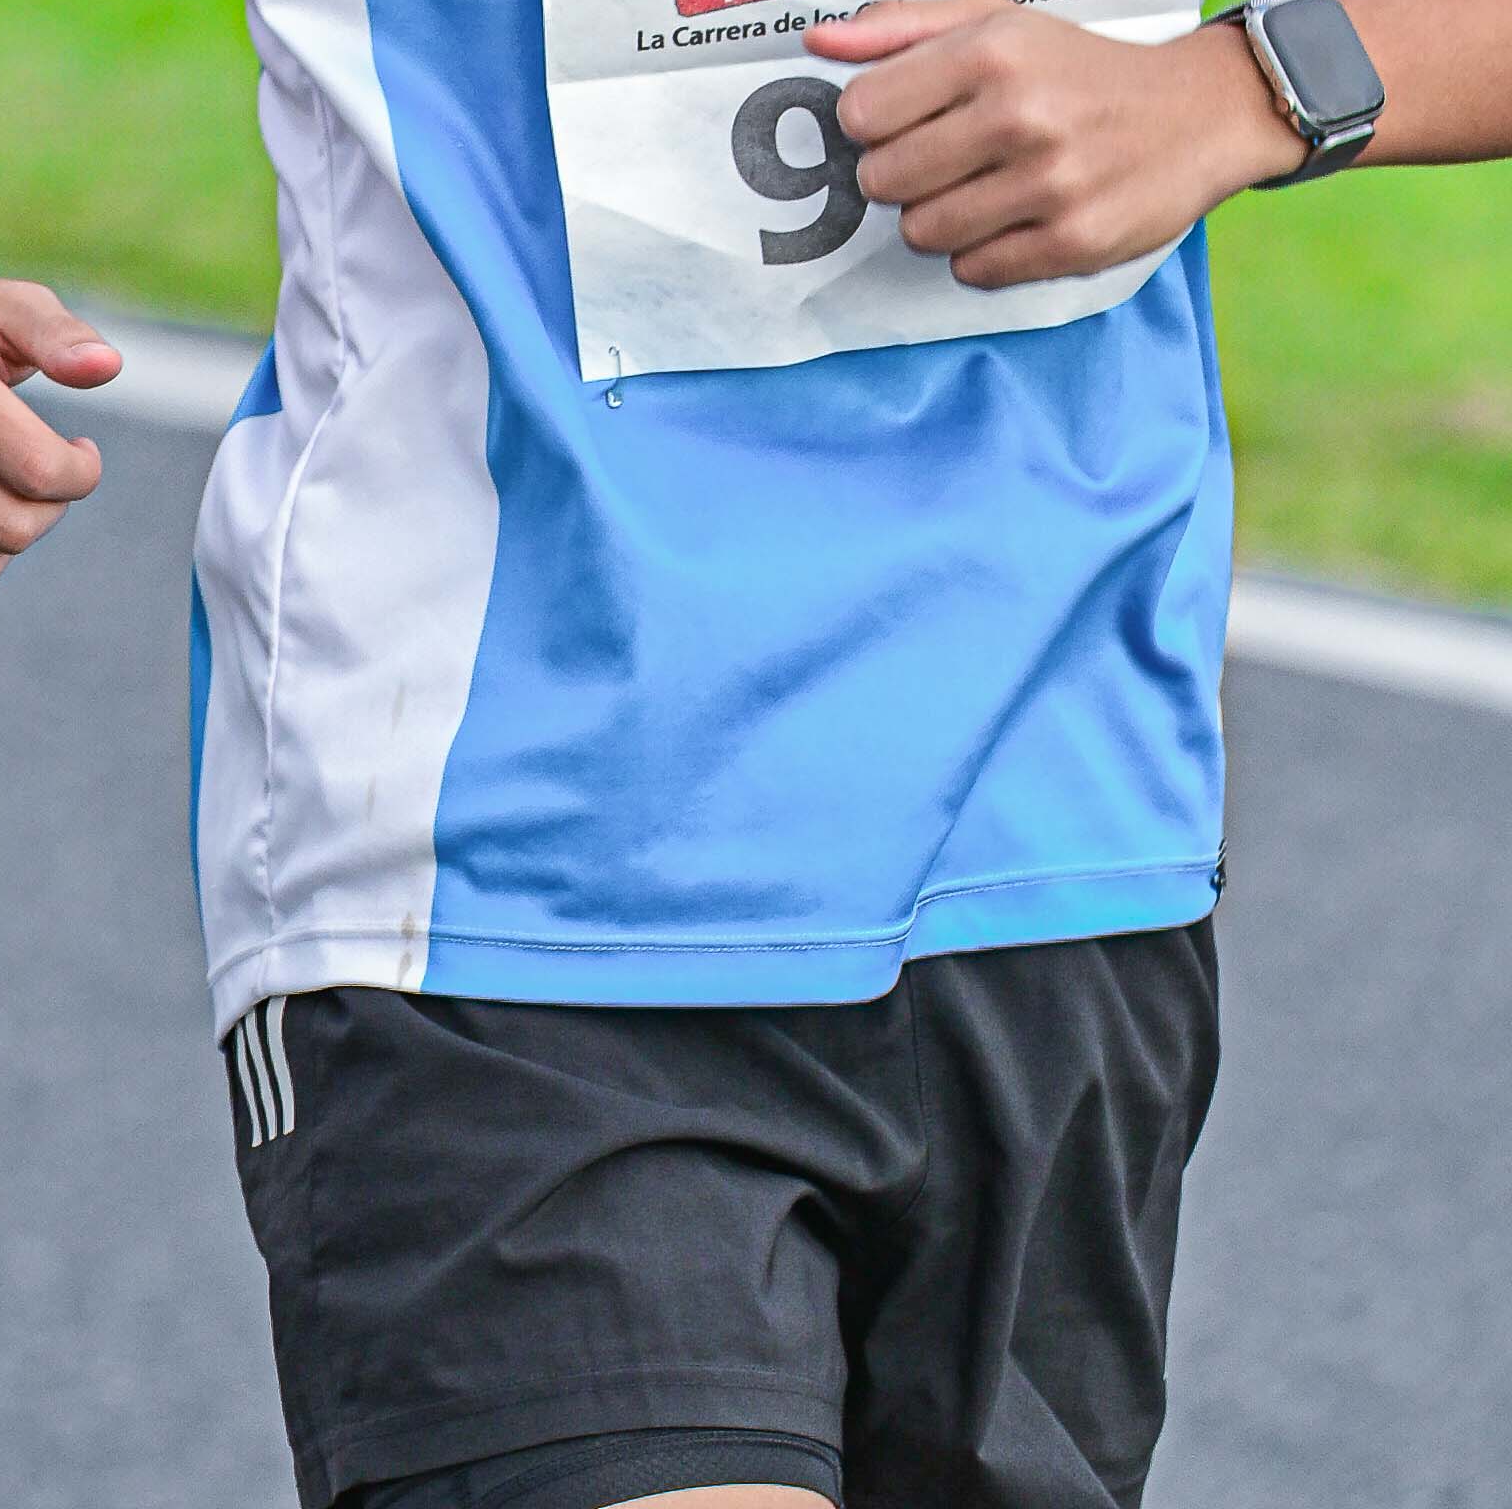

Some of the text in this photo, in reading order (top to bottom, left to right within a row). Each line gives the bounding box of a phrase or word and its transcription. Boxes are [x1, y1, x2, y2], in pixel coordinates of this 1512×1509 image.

[637, 30, 665, 52] La
[672, 21, 766, 47] Carrera
[773, 11, 807, 34] de
